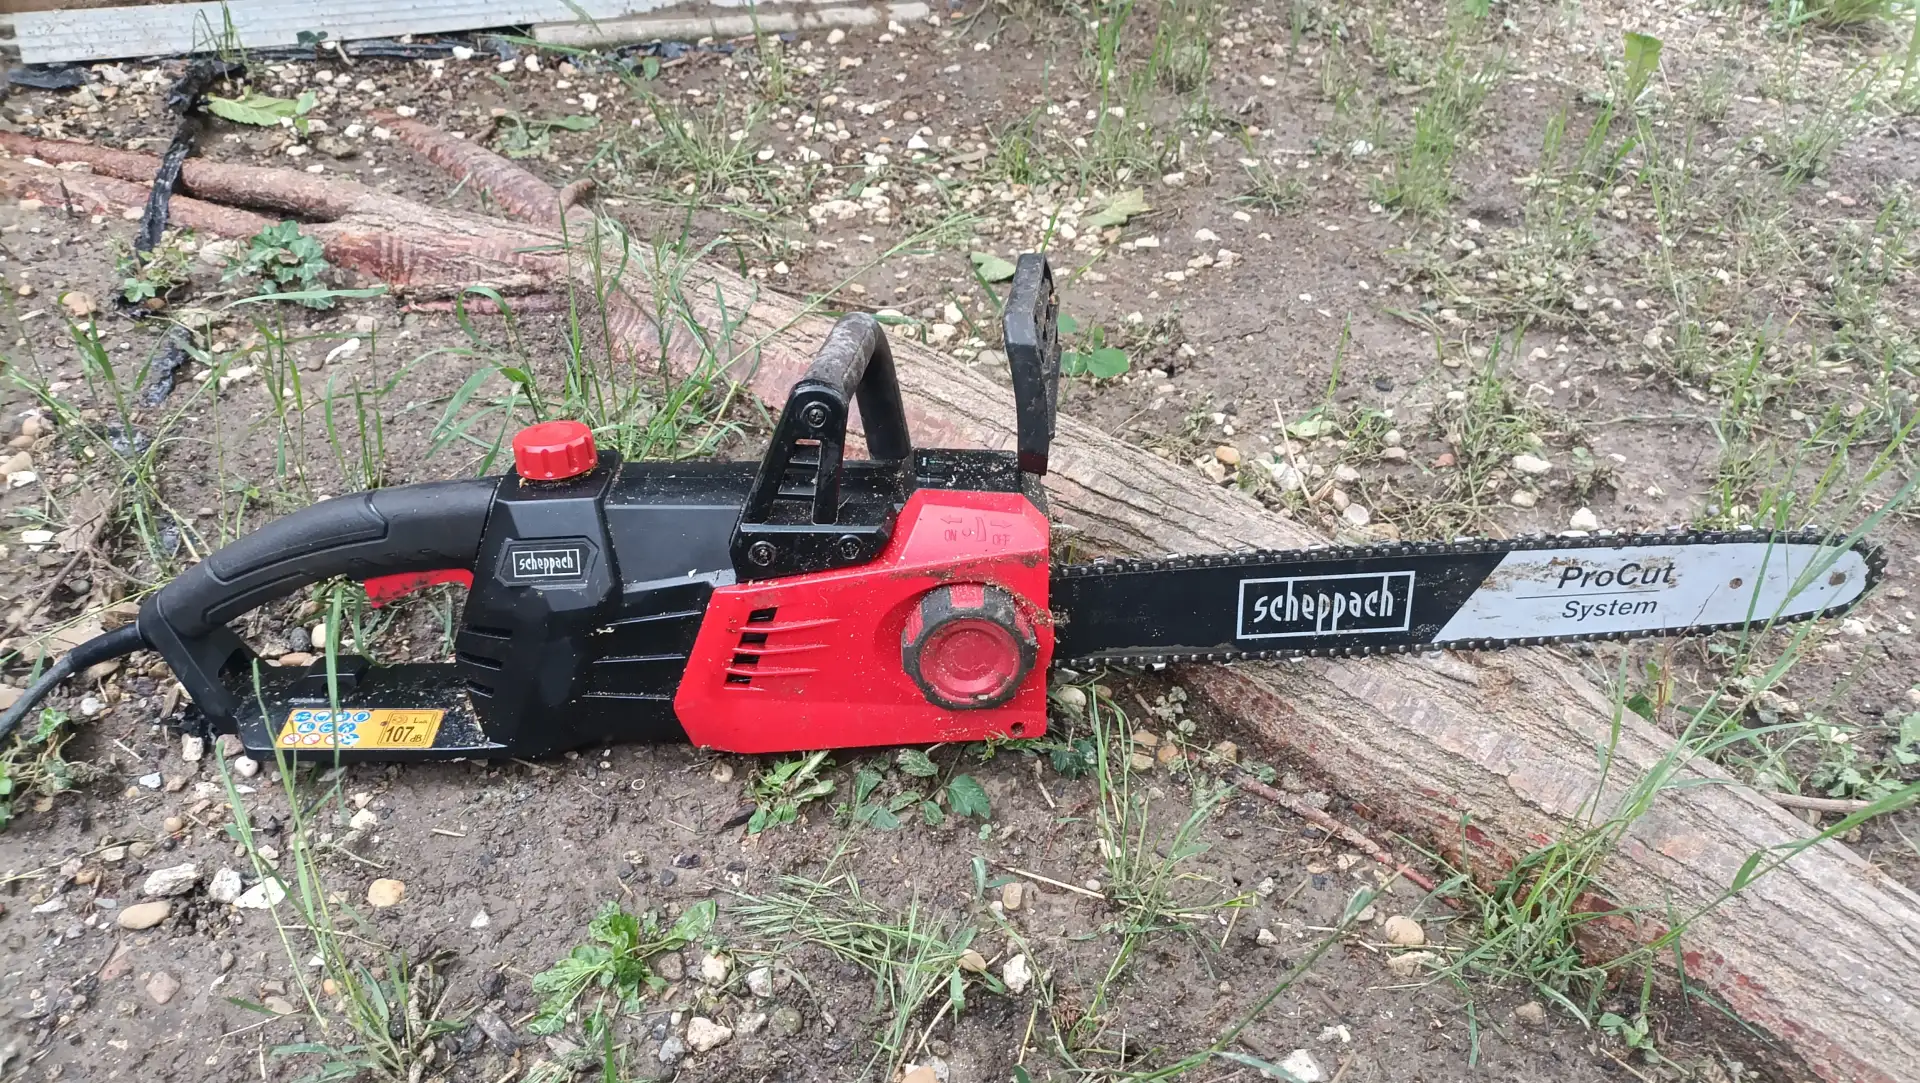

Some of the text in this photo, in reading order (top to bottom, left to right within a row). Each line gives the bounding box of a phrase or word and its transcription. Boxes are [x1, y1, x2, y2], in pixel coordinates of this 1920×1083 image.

[944, 529, 957, 541] ON
[992, 534, 1011, 546] OFF
[519, 551, 574, 575] scheppach
[1557, 562, 1676, 589] ProCut
[1253, 576, 1394, 632] scheppach
[1562, 600, 1657, 621] System
[386, 726, 422, 743] 107 dB
